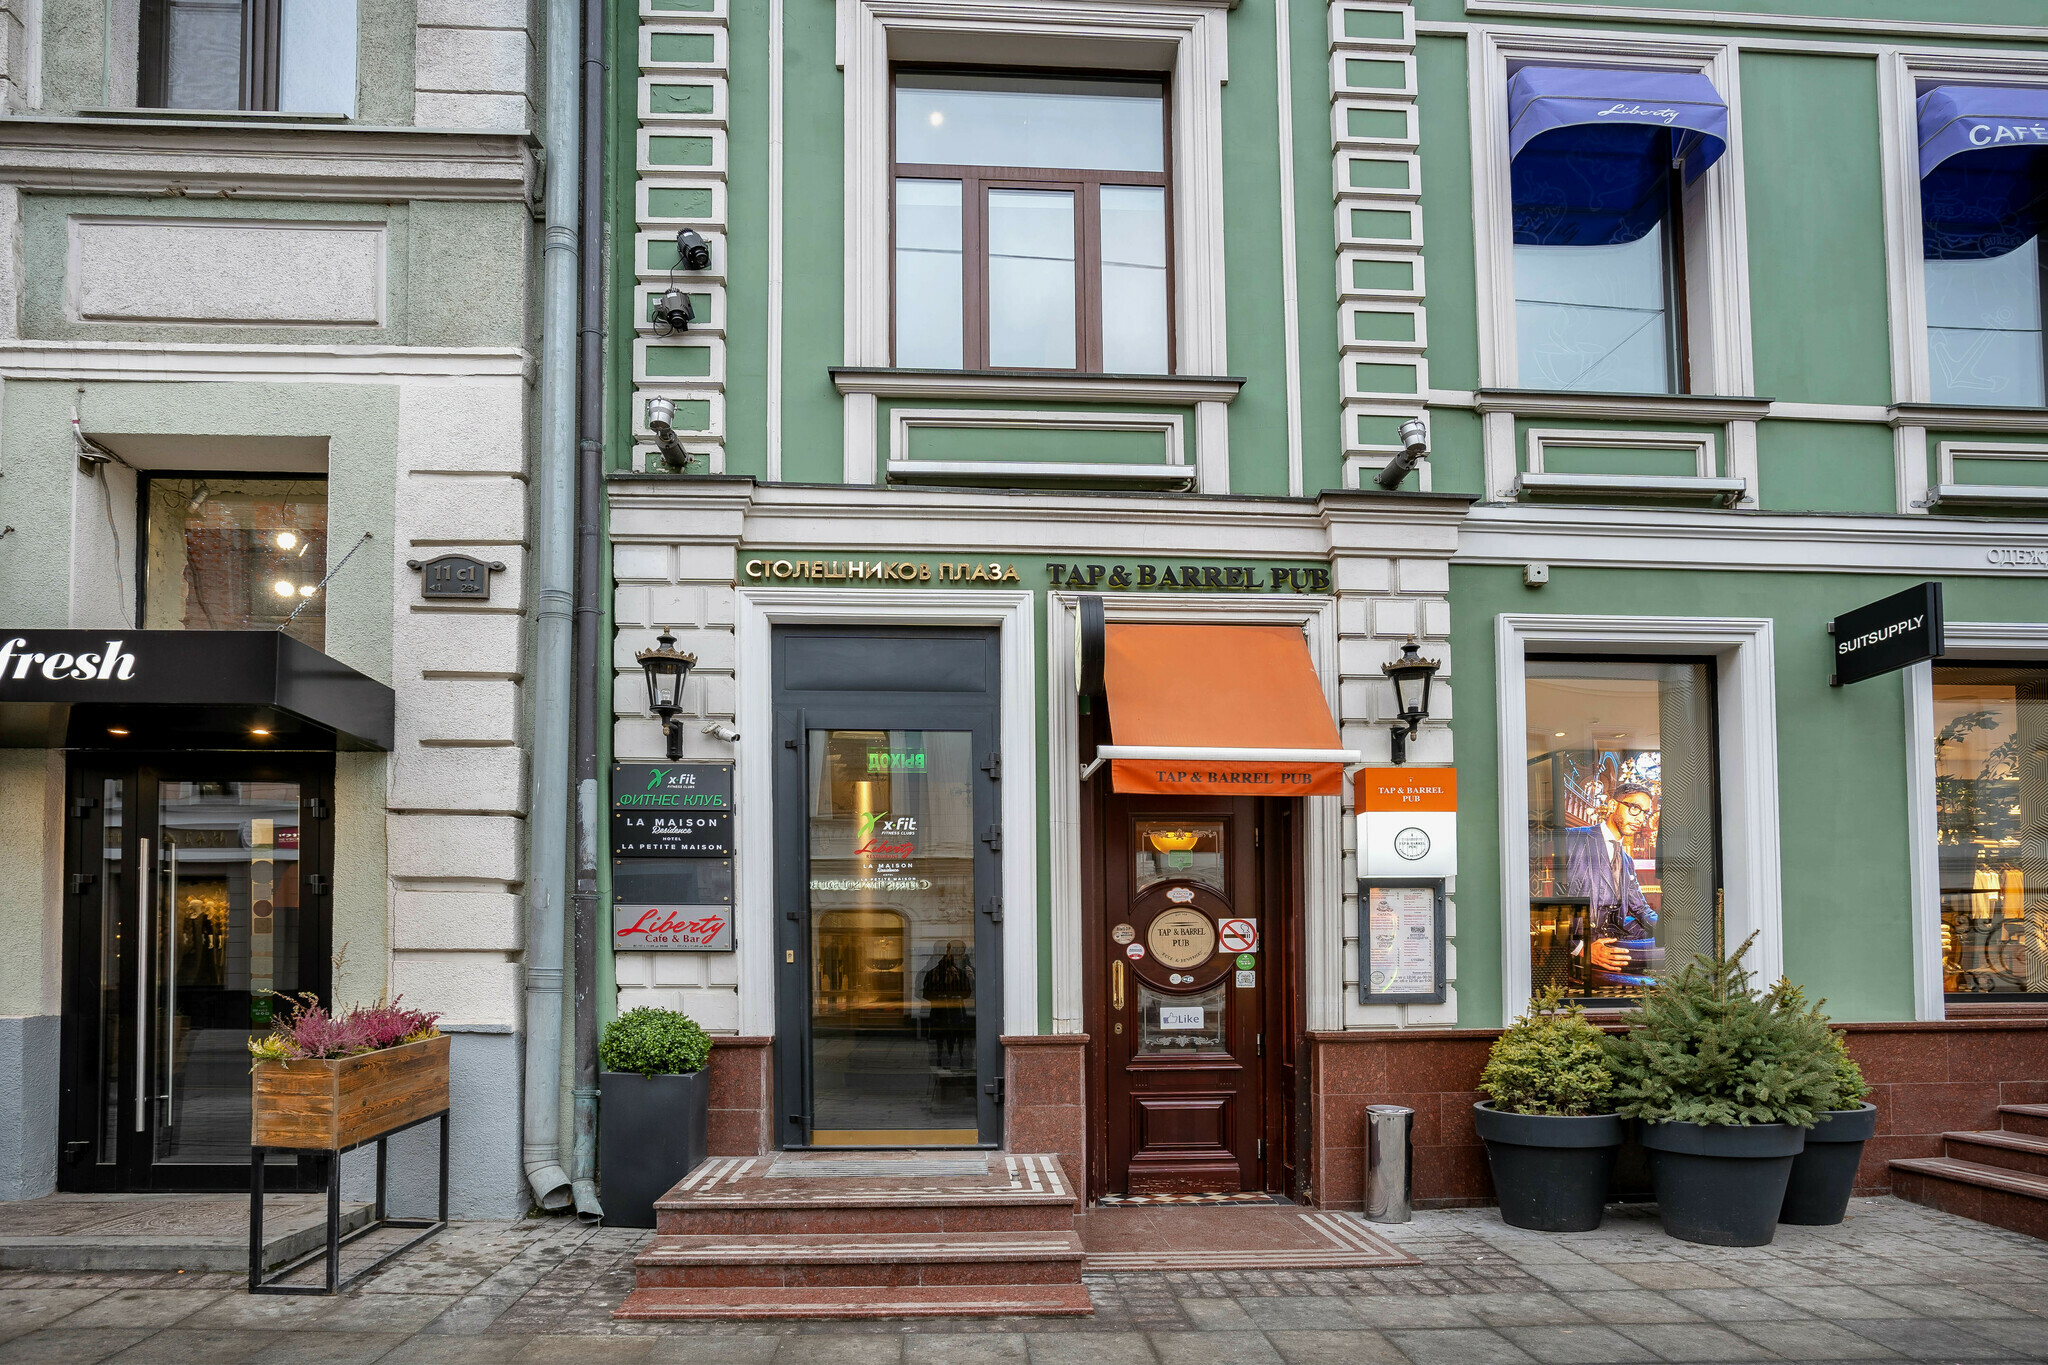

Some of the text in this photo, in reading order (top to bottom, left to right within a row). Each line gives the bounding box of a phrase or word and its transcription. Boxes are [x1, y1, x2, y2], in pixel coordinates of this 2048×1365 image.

[1597, 103, 1680, 124] Liberty
[1968, 123, 2048, 146] CAFÉ
[1987, 549, 2048, 567] ОДЕЖ
[434, 565, 452, 580] 11
[745, 559, 1020, 582] СТОЛЕШНИКОВ ПЛАЗА
[1046, 563, 1331, 591] TAP & BARREL PUB
[461, 583, 474, 592] 23
[1838, 614, 1924, 655] SUITSUPPLY
[0, 637, 136, 681] fresh
[1156, 771, 1312, 785] TAP & BARREL PUB
[1406, 786, 1444, 794] BARREL
[620, 794, 723, 806] ФИТНЕС КЛУБ
[626, 818, 717, 827] LA MAISON
[853, 838, 916, 860] Liberty
[616, 908, 726, 945] Liberty
[1157, 928, 1172, 936] TAP
[1180, 927, 1207, 935] BARREL
[645, 934, 700, 943] Cafe & Bar
[1172, 939, 1190, 947] PUB
[1178, 1014, 1200, 1024] Like
